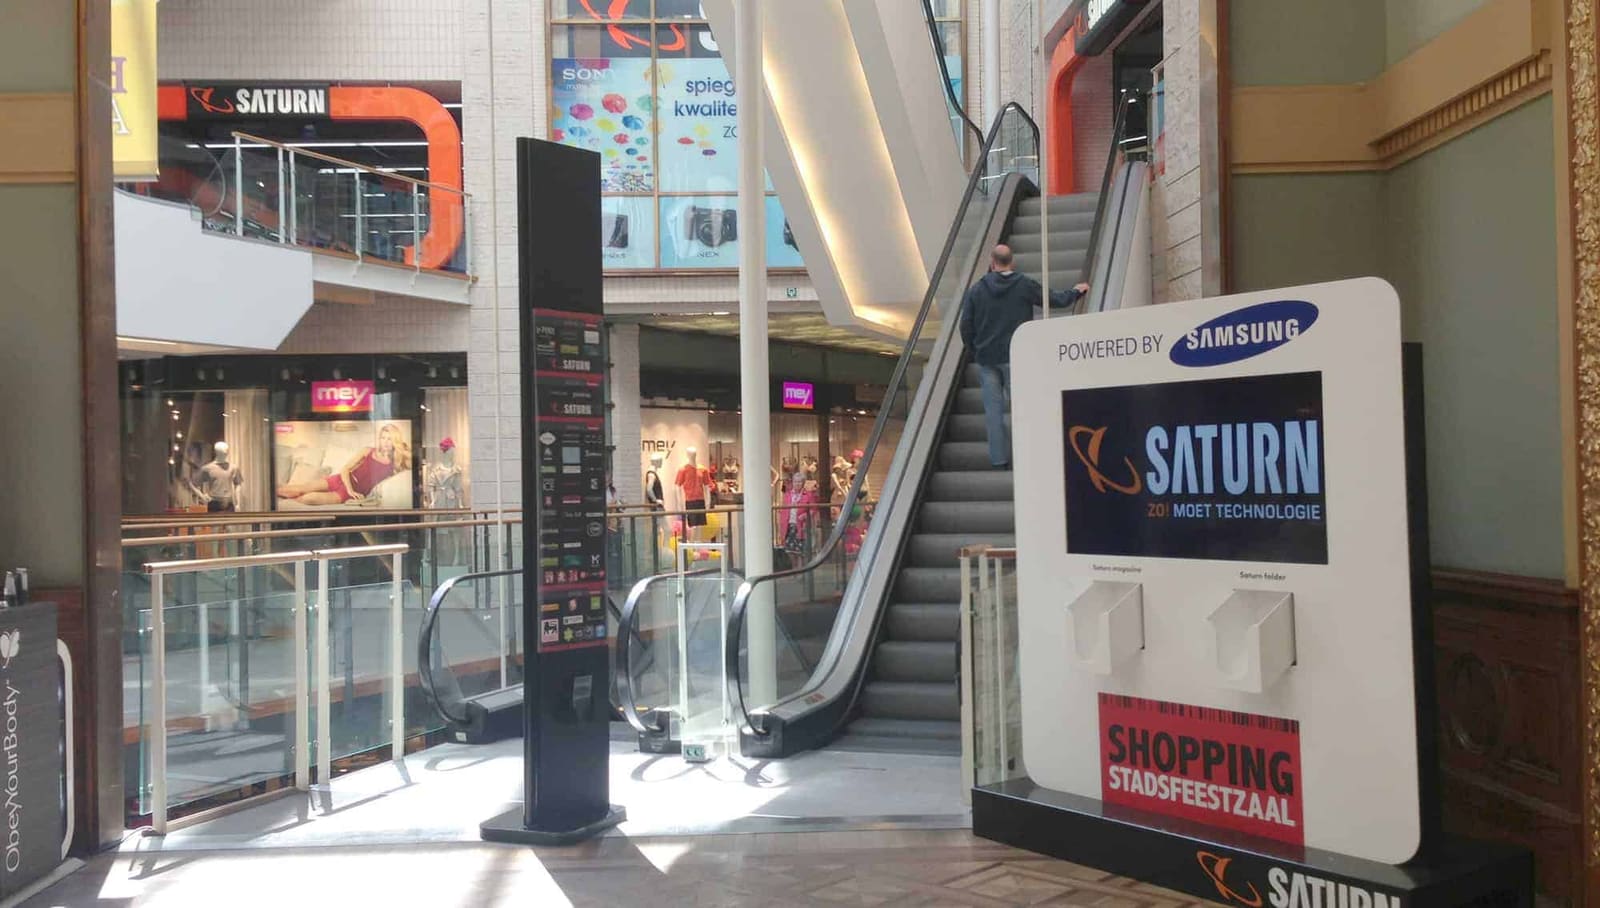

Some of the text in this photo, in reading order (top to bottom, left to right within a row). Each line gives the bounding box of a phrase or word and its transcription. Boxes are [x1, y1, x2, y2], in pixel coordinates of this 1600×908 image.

[686, 77, 736, 97] spieg
[236, 88, 325, 114] SATURN
[674, 100, 737, 117] kwalite
[1059, 318, 1300, 362] POWERED BY SAMSUNG
[317, 385, 370, 406] mey
[785, 387, 811, 405] mey
[642, 439, 676, 459] mey
[1145, 419, 1321, 496] SATURN
[1147, 503, 1321, 520] ZO! MOET TECHNOLOGIE
[1108, 723, 1294, 797] SHOPPING
[4, 685, 22, 872] ObeyYourBody
[1108, 764, 1297, 827] STADSFEESTZAAL
